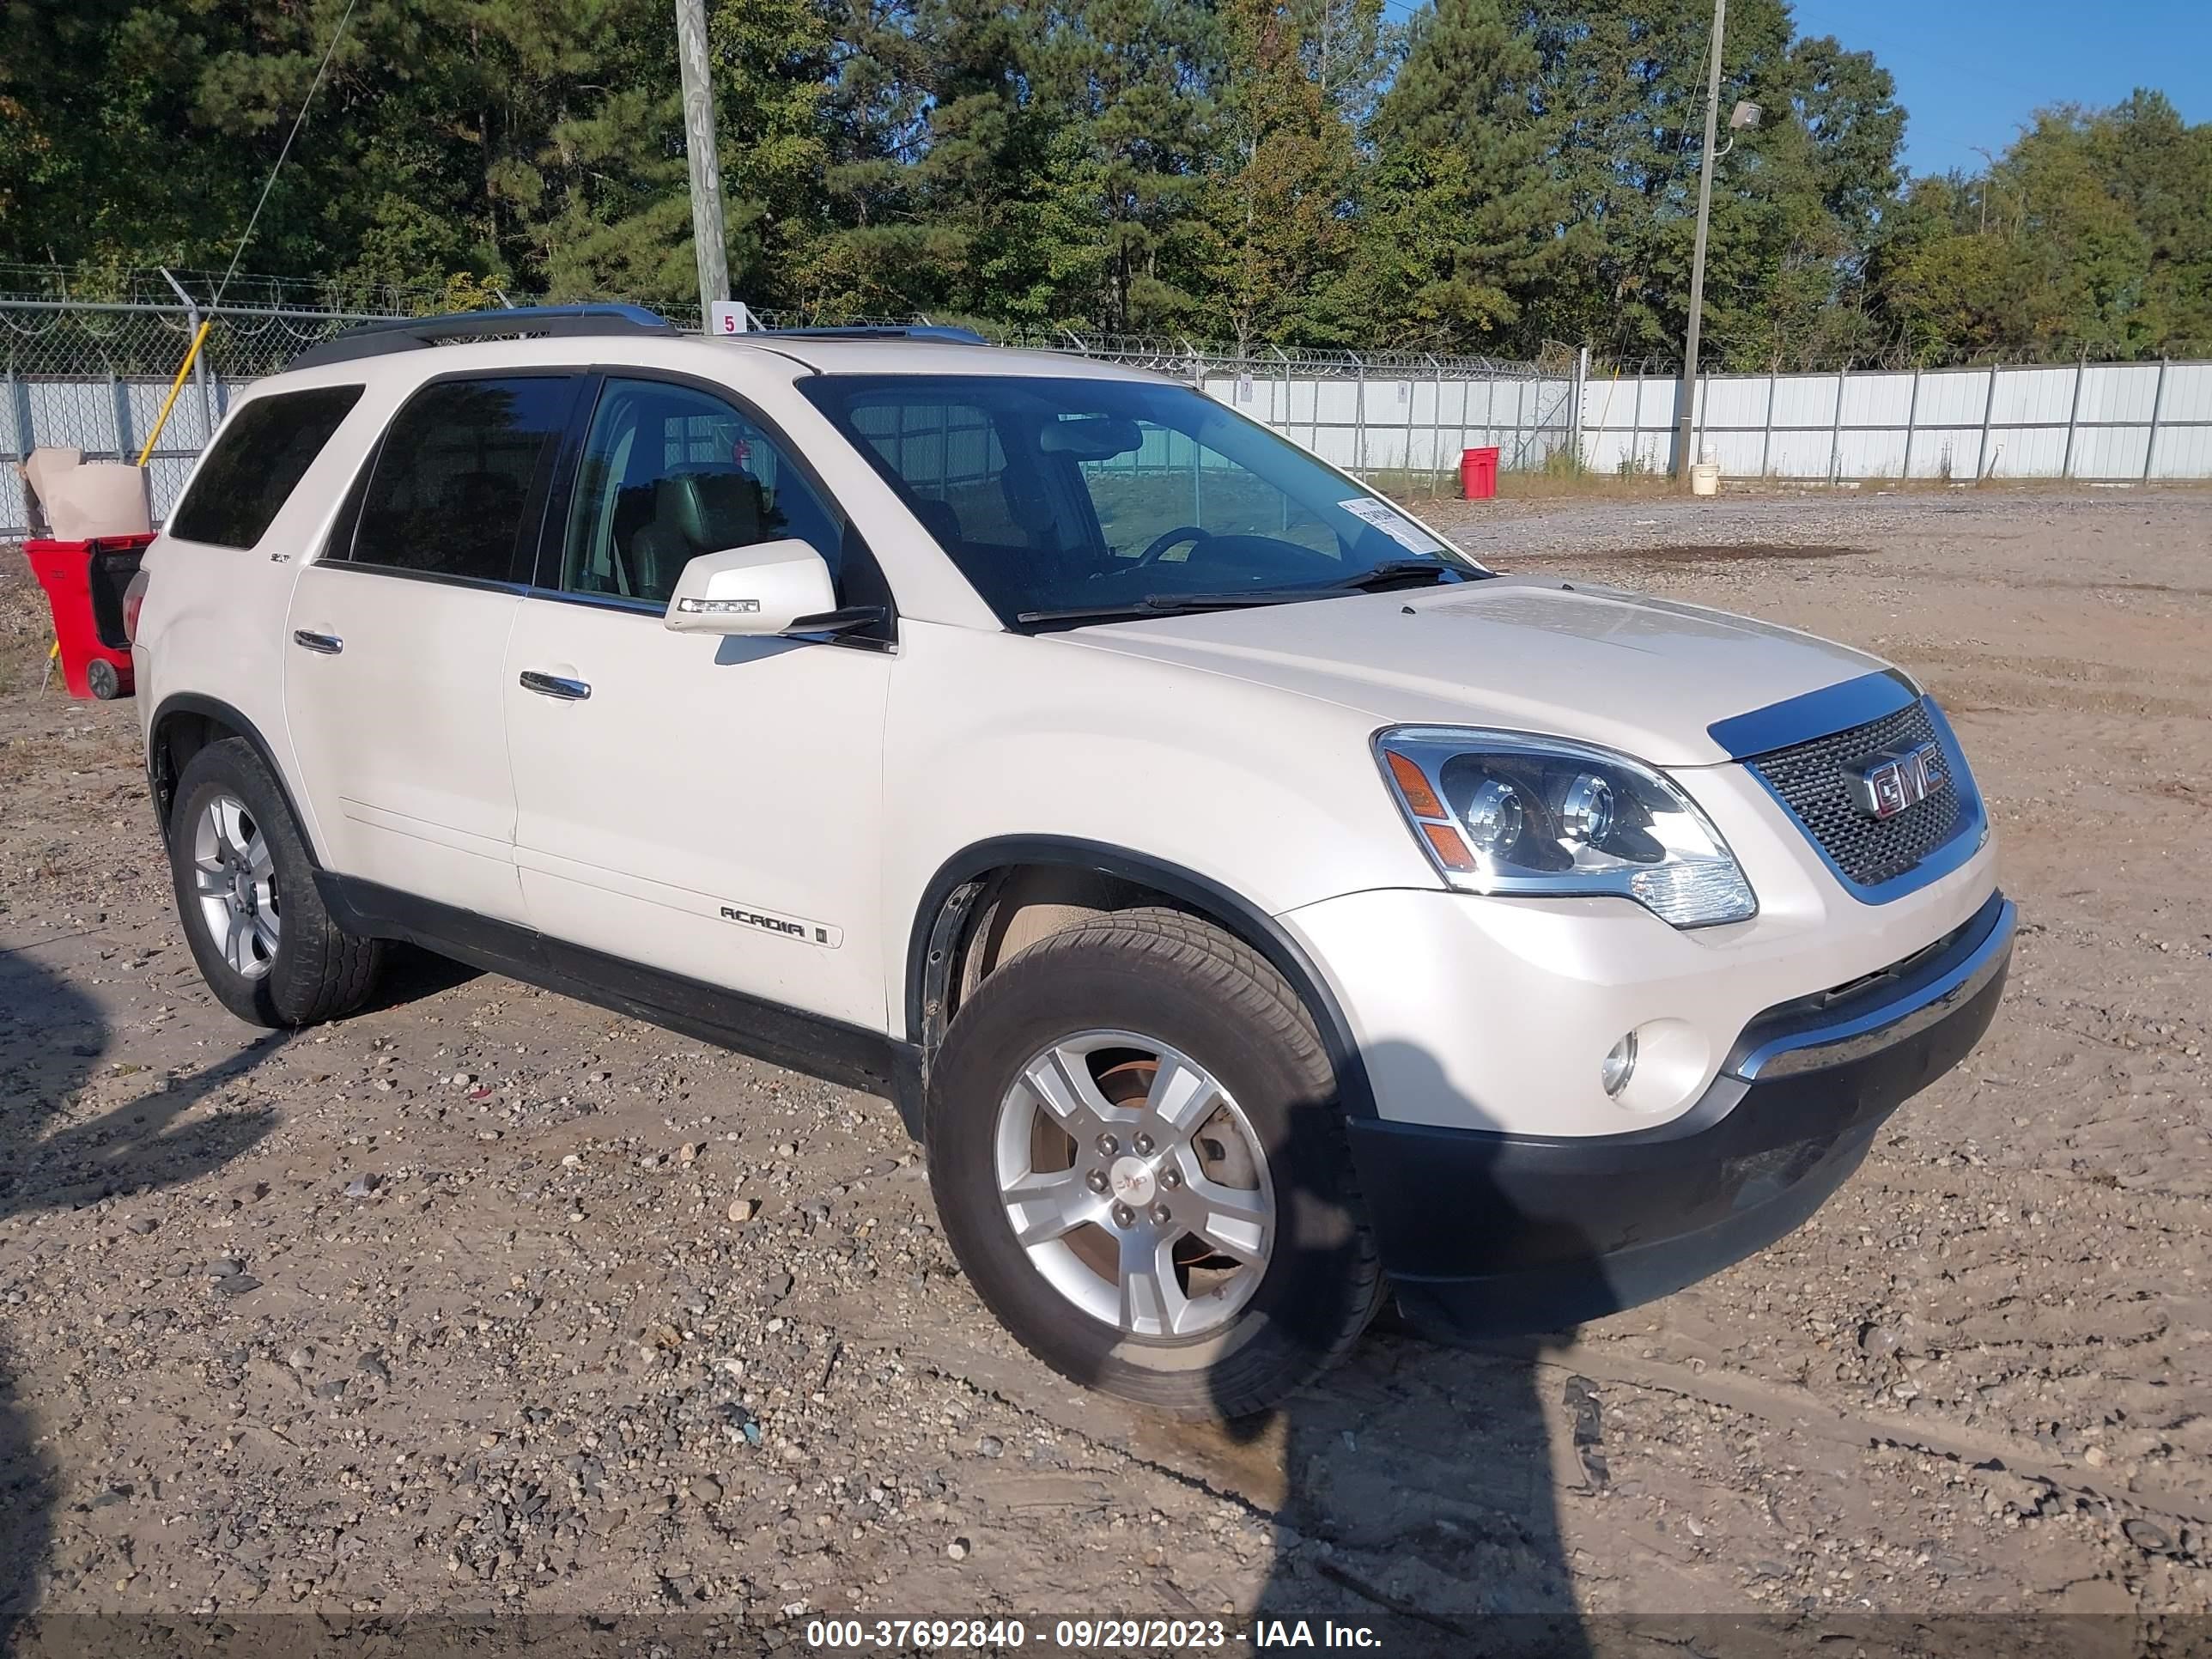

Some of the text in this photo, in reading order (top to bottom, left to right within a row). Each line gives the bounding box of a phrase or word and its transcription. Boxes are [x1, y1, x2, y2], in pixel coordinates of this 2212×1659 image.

[724, 315, 735, 332] 5
[1865, 740, 1946, 819] GMC
[720, 906, 805, 938] ACADIA
